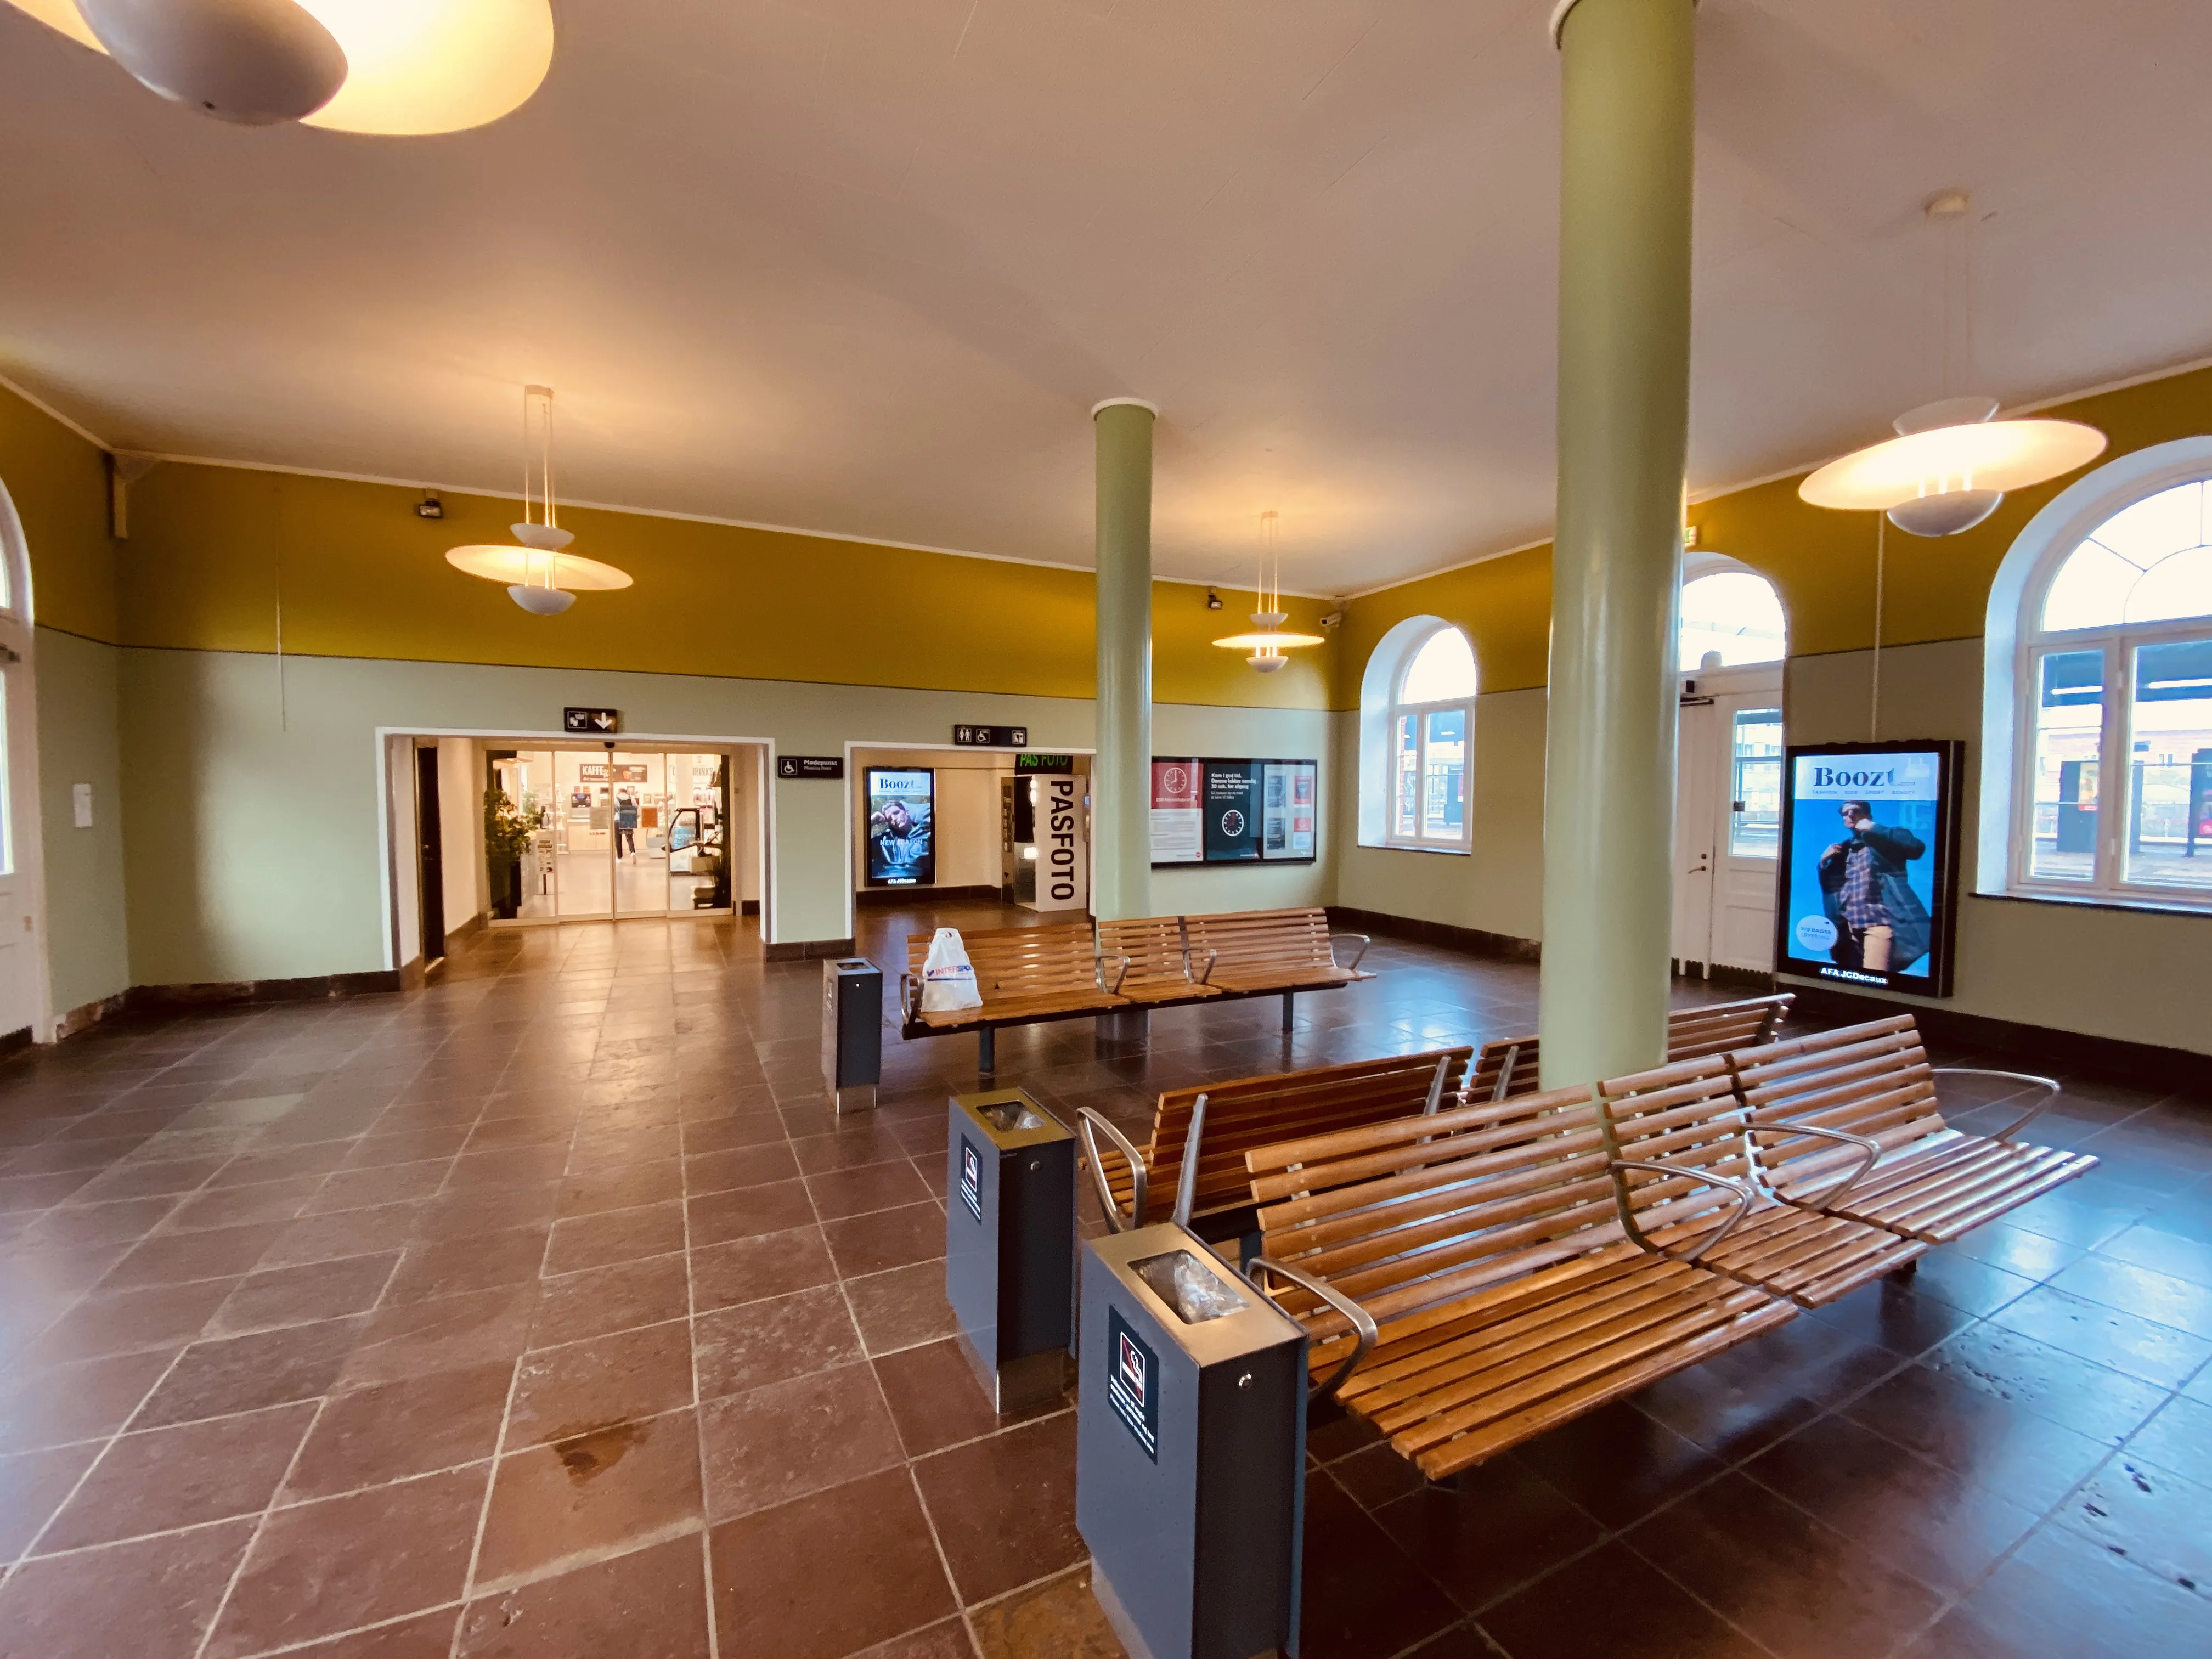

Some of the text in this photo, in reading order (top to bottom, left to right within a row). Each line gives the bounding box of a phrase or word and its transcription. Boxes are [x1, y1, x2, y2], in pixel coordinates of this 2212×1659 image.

[1020, 754, 1038, 766] PAS
[582, 765, 604, 775] KAFFE
[1051, 781, 1074, 900] PASFOTO
[935, 965, 971, 975] INTERSPO
[1821, 967, 1888, 984] AFA JCDecaux
